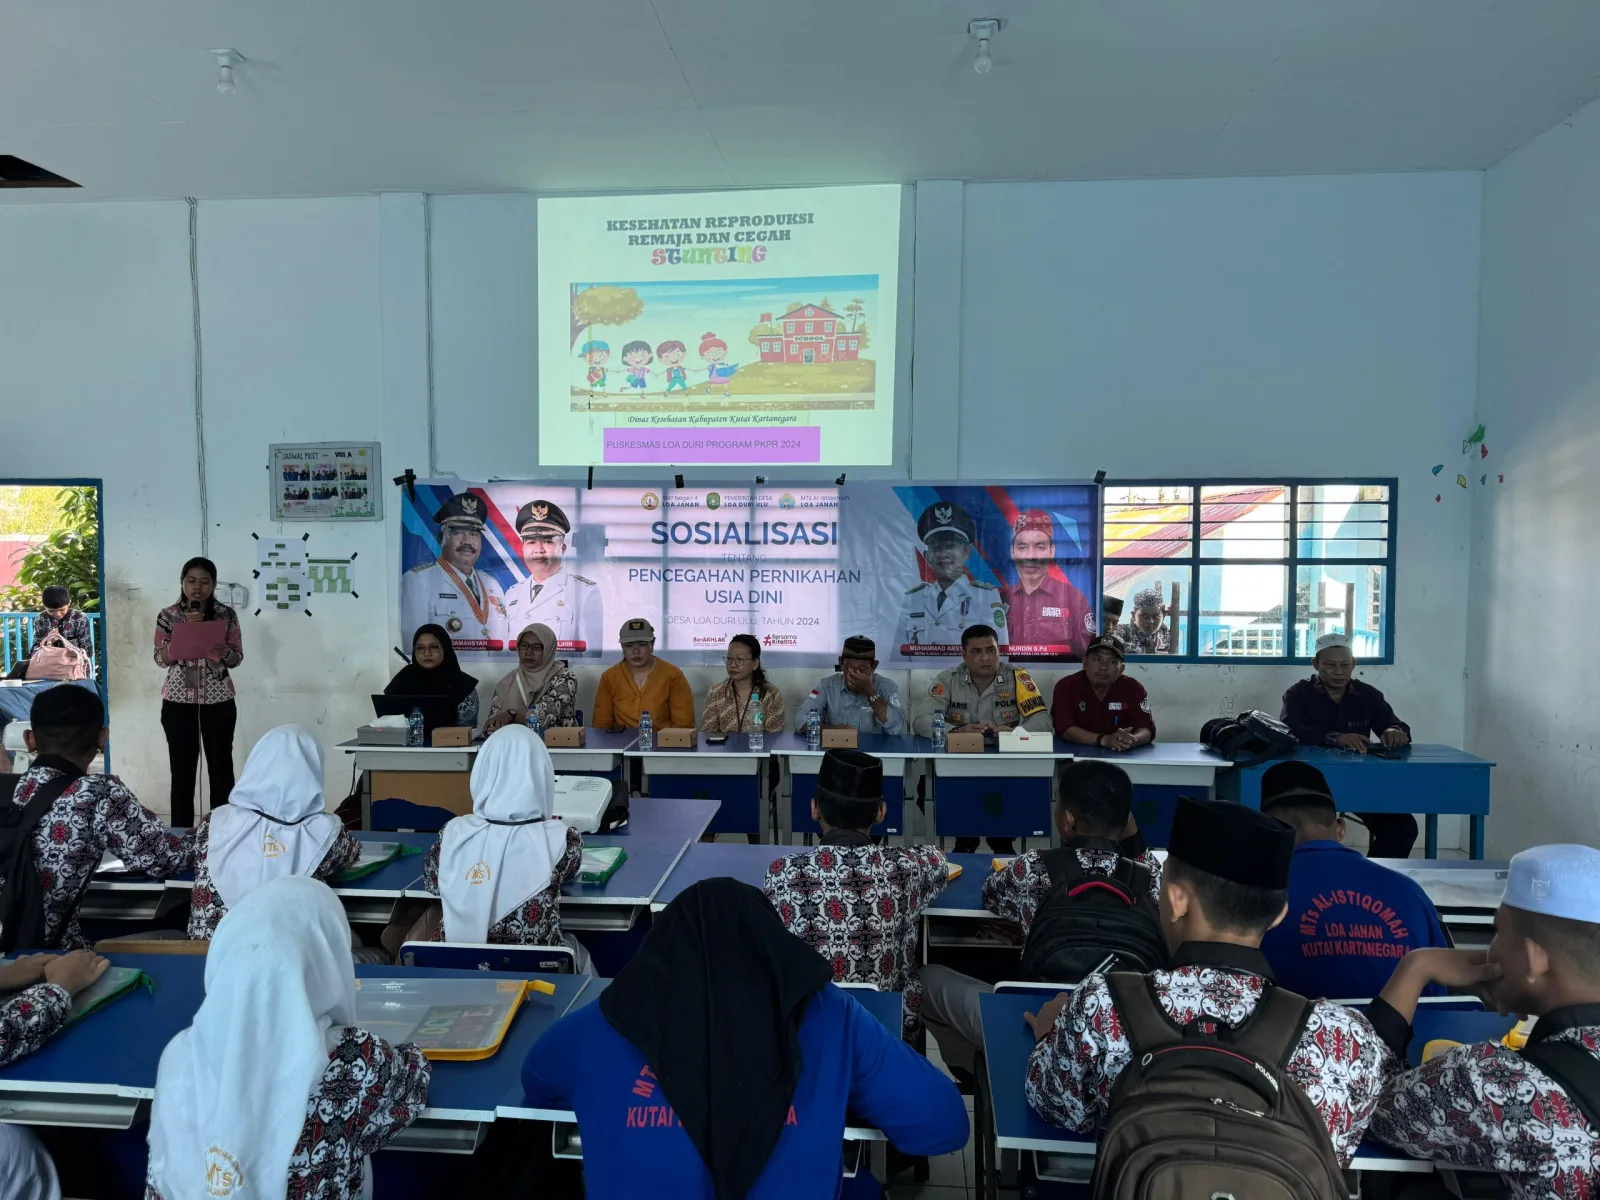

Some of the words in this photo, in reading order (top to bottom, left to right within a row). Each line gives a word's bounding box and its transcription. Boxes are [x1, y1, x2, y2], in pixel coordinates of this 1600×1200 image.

[607, 217, 701, 231] KESEHATAN
[705, 213, 814, 228] REPRODUKSI
[628, 233, 692, 246] REMAJA
[696, 232, 730, 244] DAN
[734, 230, 791, 242] CEGAH
[689, 416, 728, 424] Kabupaten
[752, 415, 797, 424] Kartanegara
[663, 440, 680, 448] LOA
[682, 440, 703, 448] DURI
[706, 440, 752, 448] PROGRAM
[754, 440, 778, 448] PKPR
[781, 440, 800, 448] 2024
[651, 521, 837, 546] SOSIALISASI
[722, 554, 766, 562] TENTANG
[628, 568, 744, 582] PENCEGAHAN
[750, 569, 861, 584] PERNIKAHAN
[705, 590, 744, 604] USIA
[749, 590, 782, 604] DINI
[667, 616, 691, 624] DESA
[693, 616, 711, 625] LOA
[714, 616, 736, 625] DURI
[761, 617, 795, 626] TAHUN
[797, 617, 820, 626] 2024
[995, 699, 1015, 708] POLR
[1300, 910, 1320, 936] MTs
[1324, 923, 1346, 937] LOA
[1348, 924, 1383, 939] JANAN
[1302, 941, 1334, 957] KUTAI
[632, 1064, 658, 1098] MT
[626, 1105, 674, 1128] KUTAI
